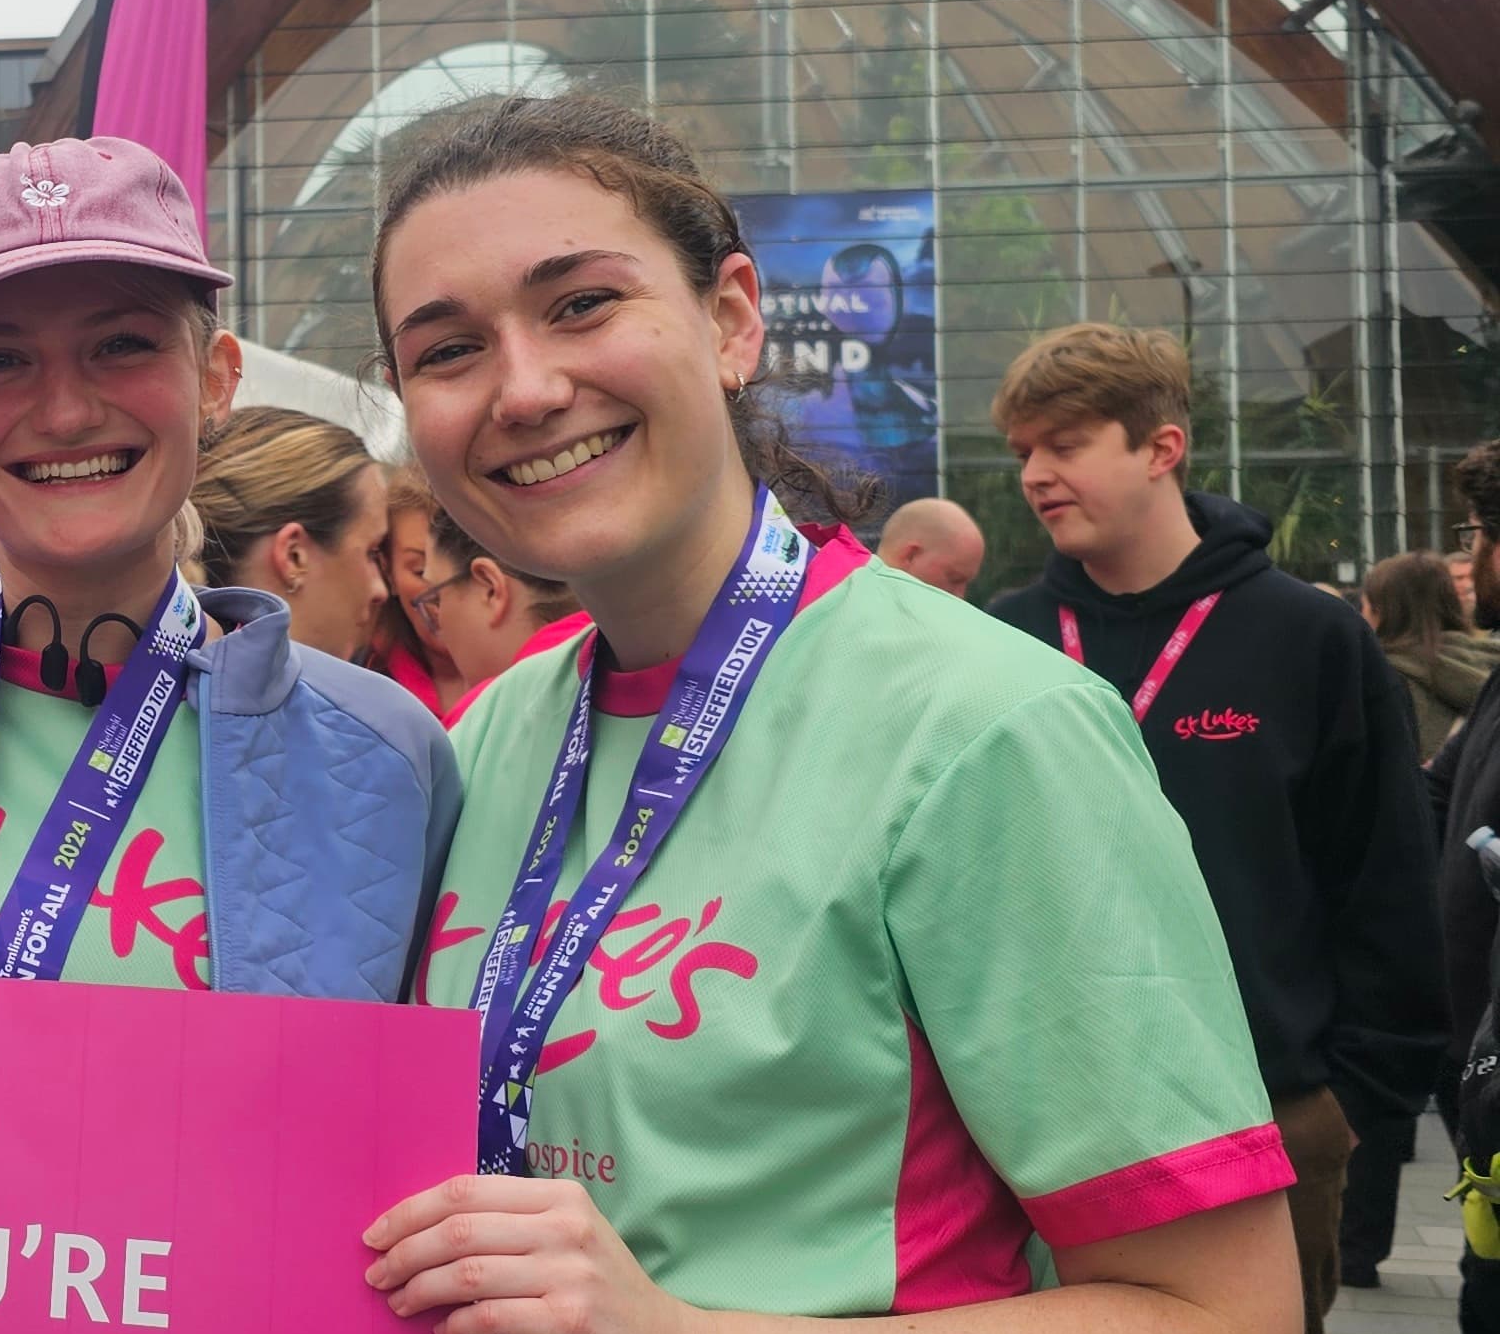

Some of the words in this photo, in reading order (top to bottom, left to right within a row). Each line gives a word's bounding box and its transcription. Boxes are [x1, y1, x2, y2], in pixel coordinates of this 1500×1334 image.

[687, 658, 745, 754] SHEFFIELD
[734, 622, 769, 656] 10K
[114, 704, 157, 782] SHEFFIELD
[148, 671, 175, 706] 10K
[53, 820, 92, 871] 2024
[40, 883, 71, 920] ALL
[530, 971, 564, 1022] RUN
[558, 923, 590, 969] FOR
[586, 883, 618, 920] ALL
[614, 808, 654, 867] 2024
[21, 920, 53, 967] FOR
[526, 1139, 616, 1183] ospice
